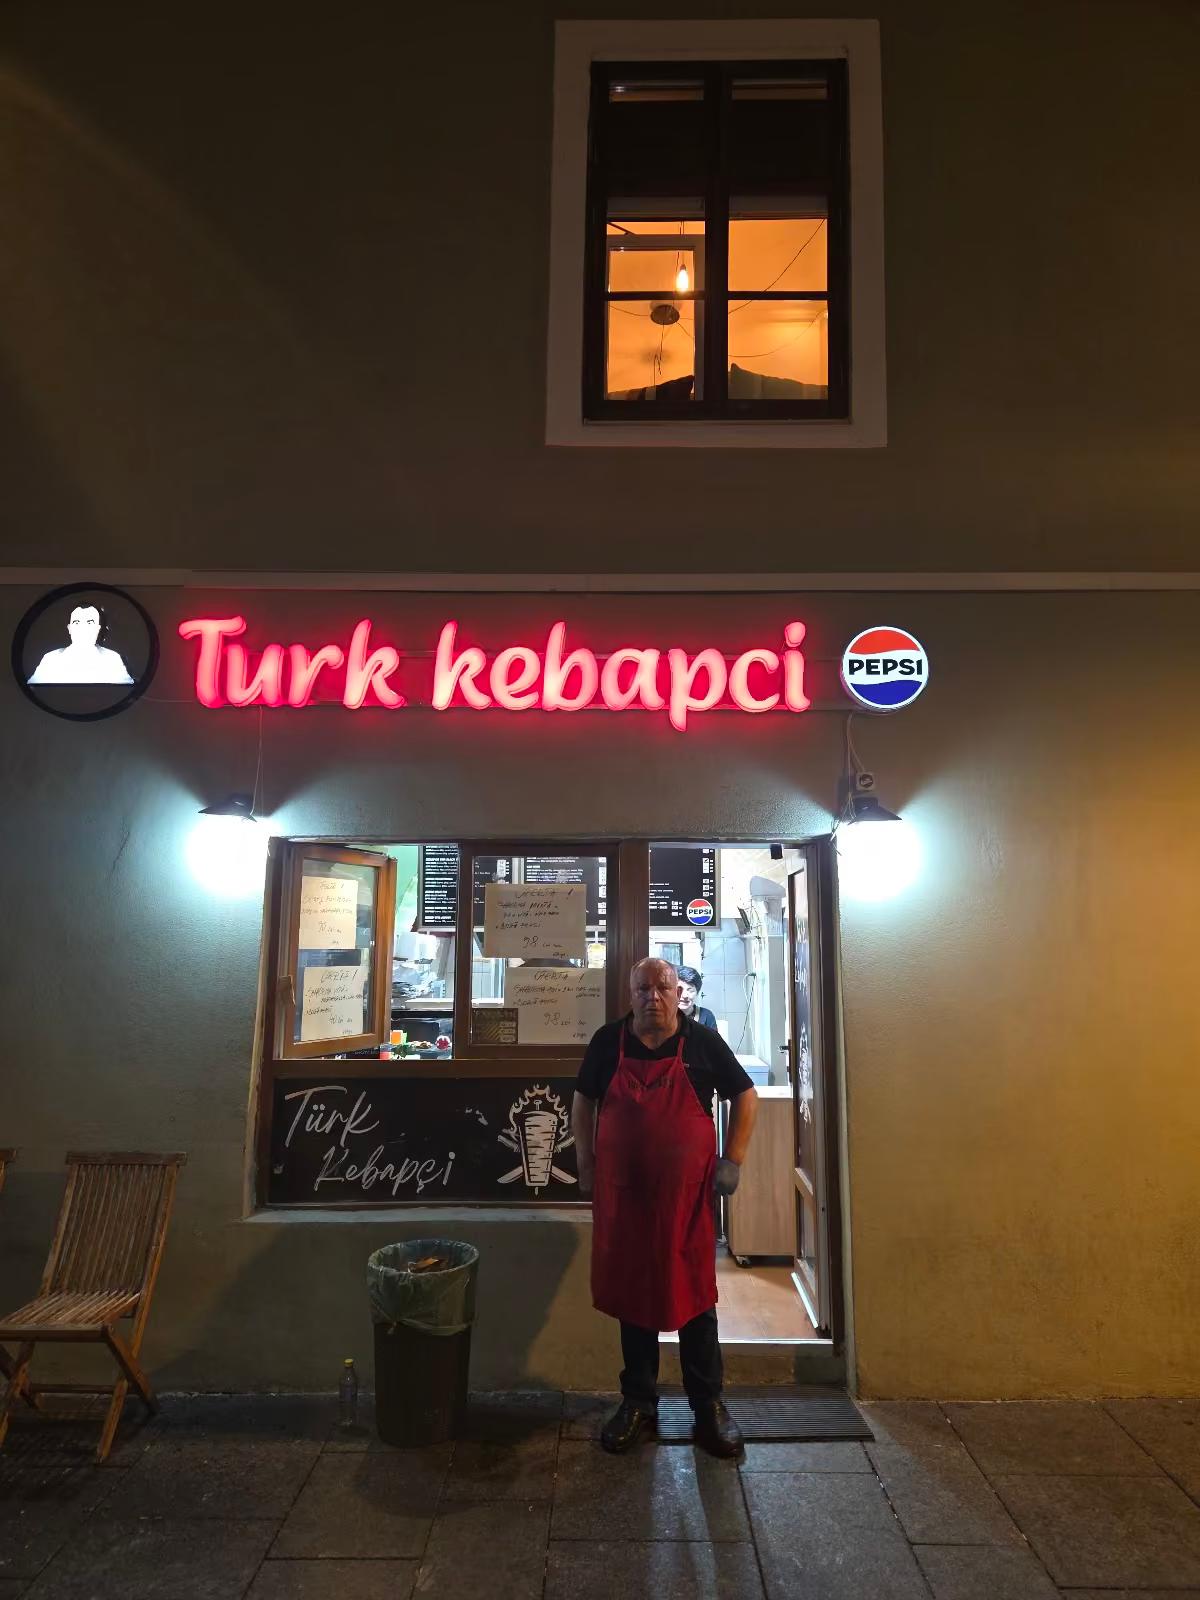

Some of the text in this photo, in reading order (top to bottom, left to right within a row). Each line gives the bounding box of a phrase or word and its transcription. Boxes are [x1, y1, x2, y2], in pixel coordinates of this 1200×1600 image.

[179, 615, 810, 732] Turk kebapci
[848, 658, 923, 676] PEPSI
[284, 1085, 380, 1148] Türk
[313, 1144, 456, 1196] Kebapçi
